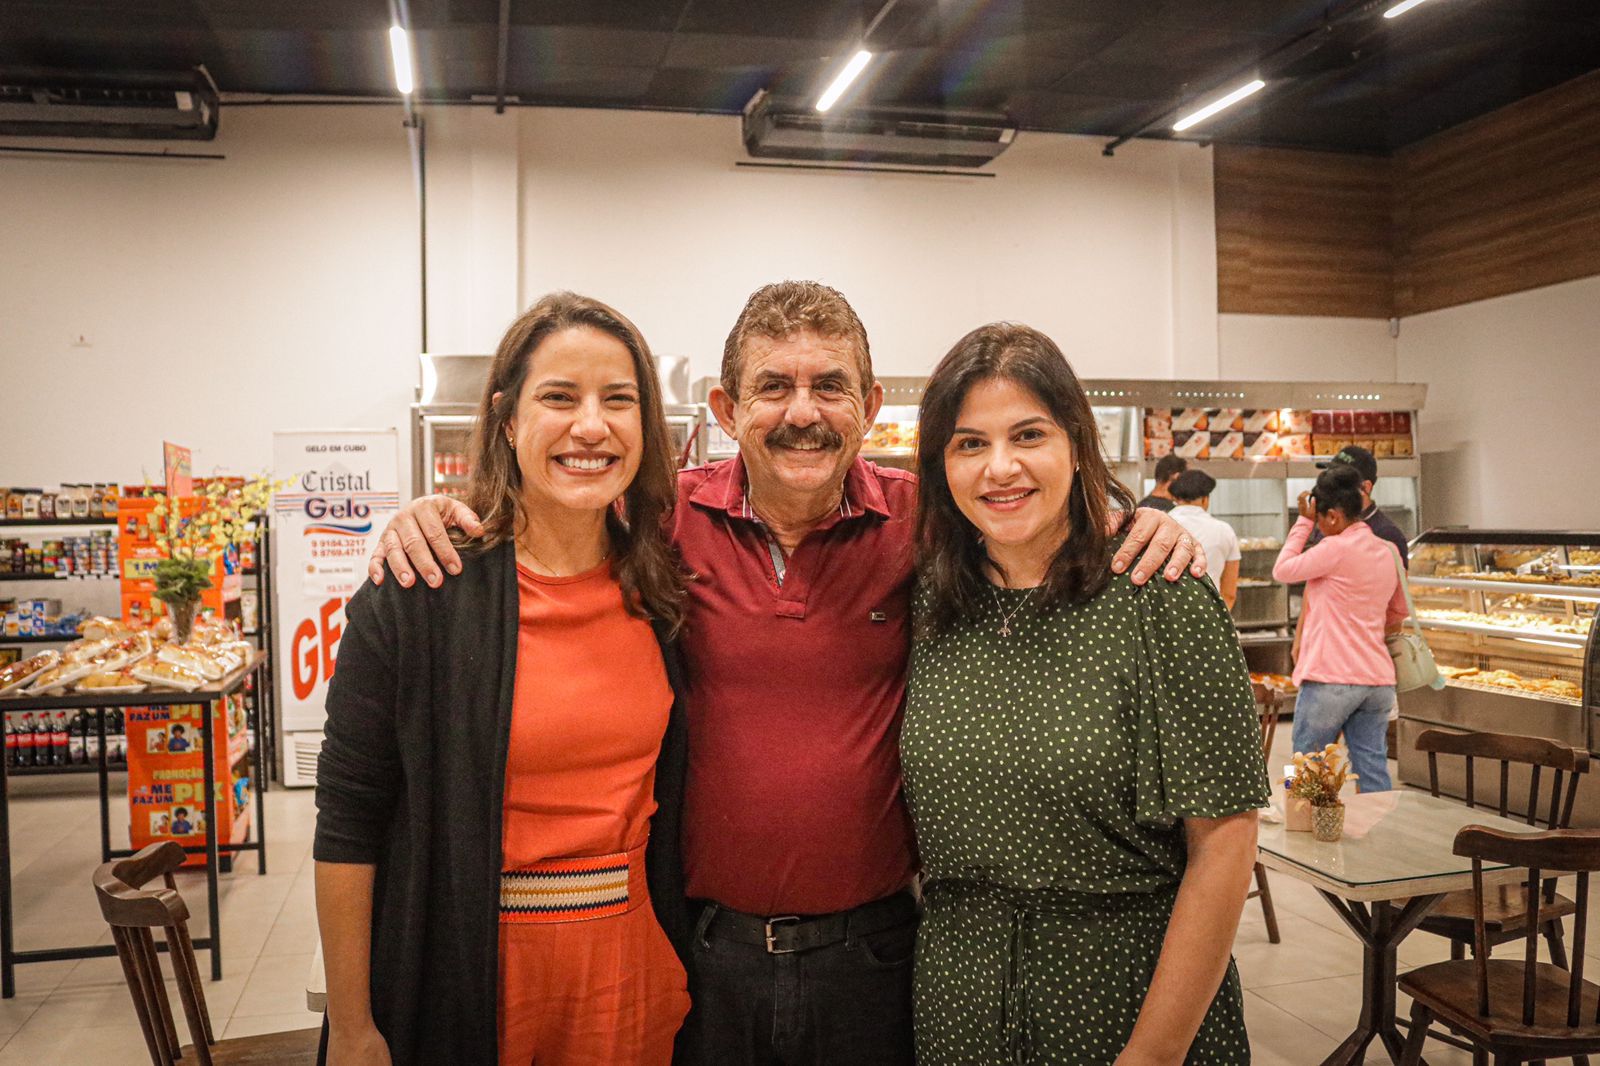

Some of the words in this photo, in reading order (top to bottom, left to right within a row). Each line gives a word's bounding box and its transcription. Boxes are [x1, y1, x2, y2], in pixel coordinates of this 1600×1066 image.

[305, 444, 327, 453] GELO
[329, 444, 341, 452] EM
[343, 444, 367, 452] CUBO
[302, 470, 371, 492] Cristal
[304, 497, 370, 519] Gelo
[291, 597, 352, 701] GE
[129, 712, 150, 721] FAZ
[152, 712, 170, 720] UM
[150, 784, 172, 794] ME
[132, 796, 154, 805] FAZ
[155, 795, 173, 804] UM
